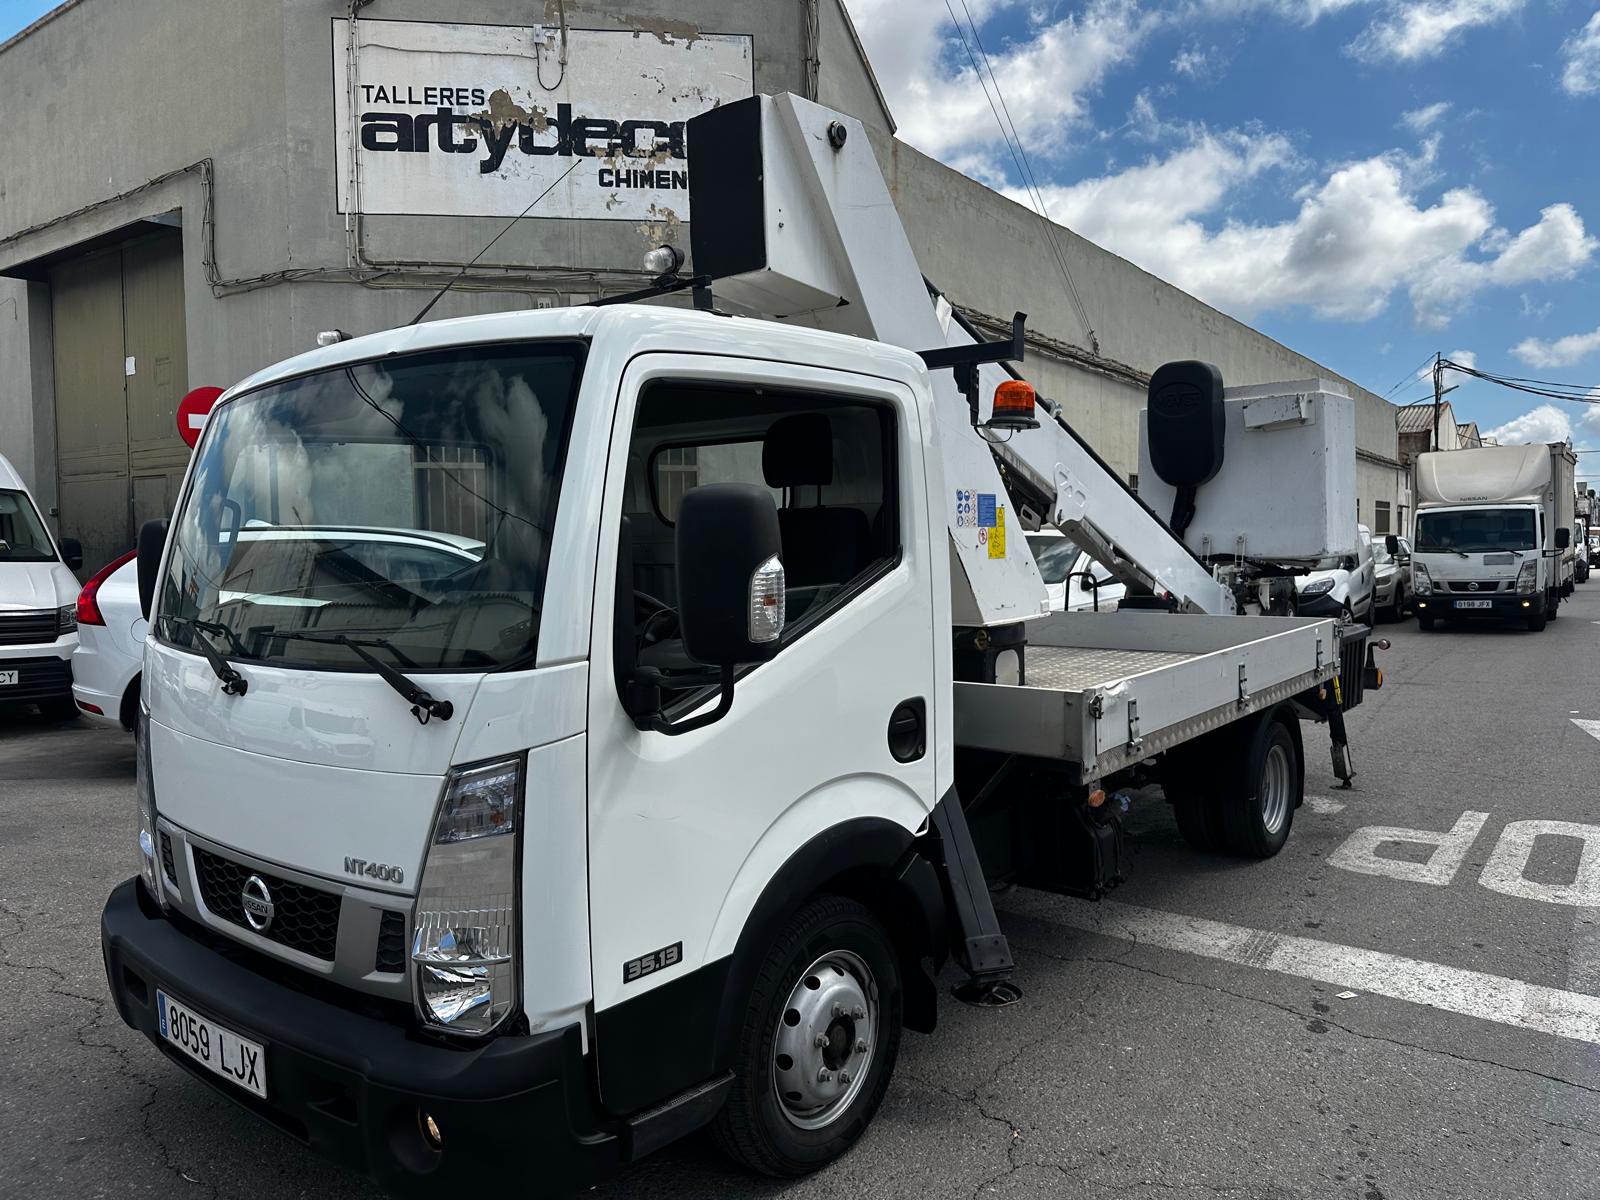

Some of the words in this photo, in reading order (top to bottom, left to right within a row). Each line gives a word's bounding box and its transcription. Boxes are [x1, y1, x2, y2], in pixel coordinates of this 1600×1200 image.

[361, 84, 485, 106] TALLERES
[598, 168, 688, 190] CHIMEN
[343, 856, 404, 884] NT400
[628, 945, 679, 980] 35.13
[170, 1005, 210, 1061] 8059
[219, 1034, 260, 1089] LJX
